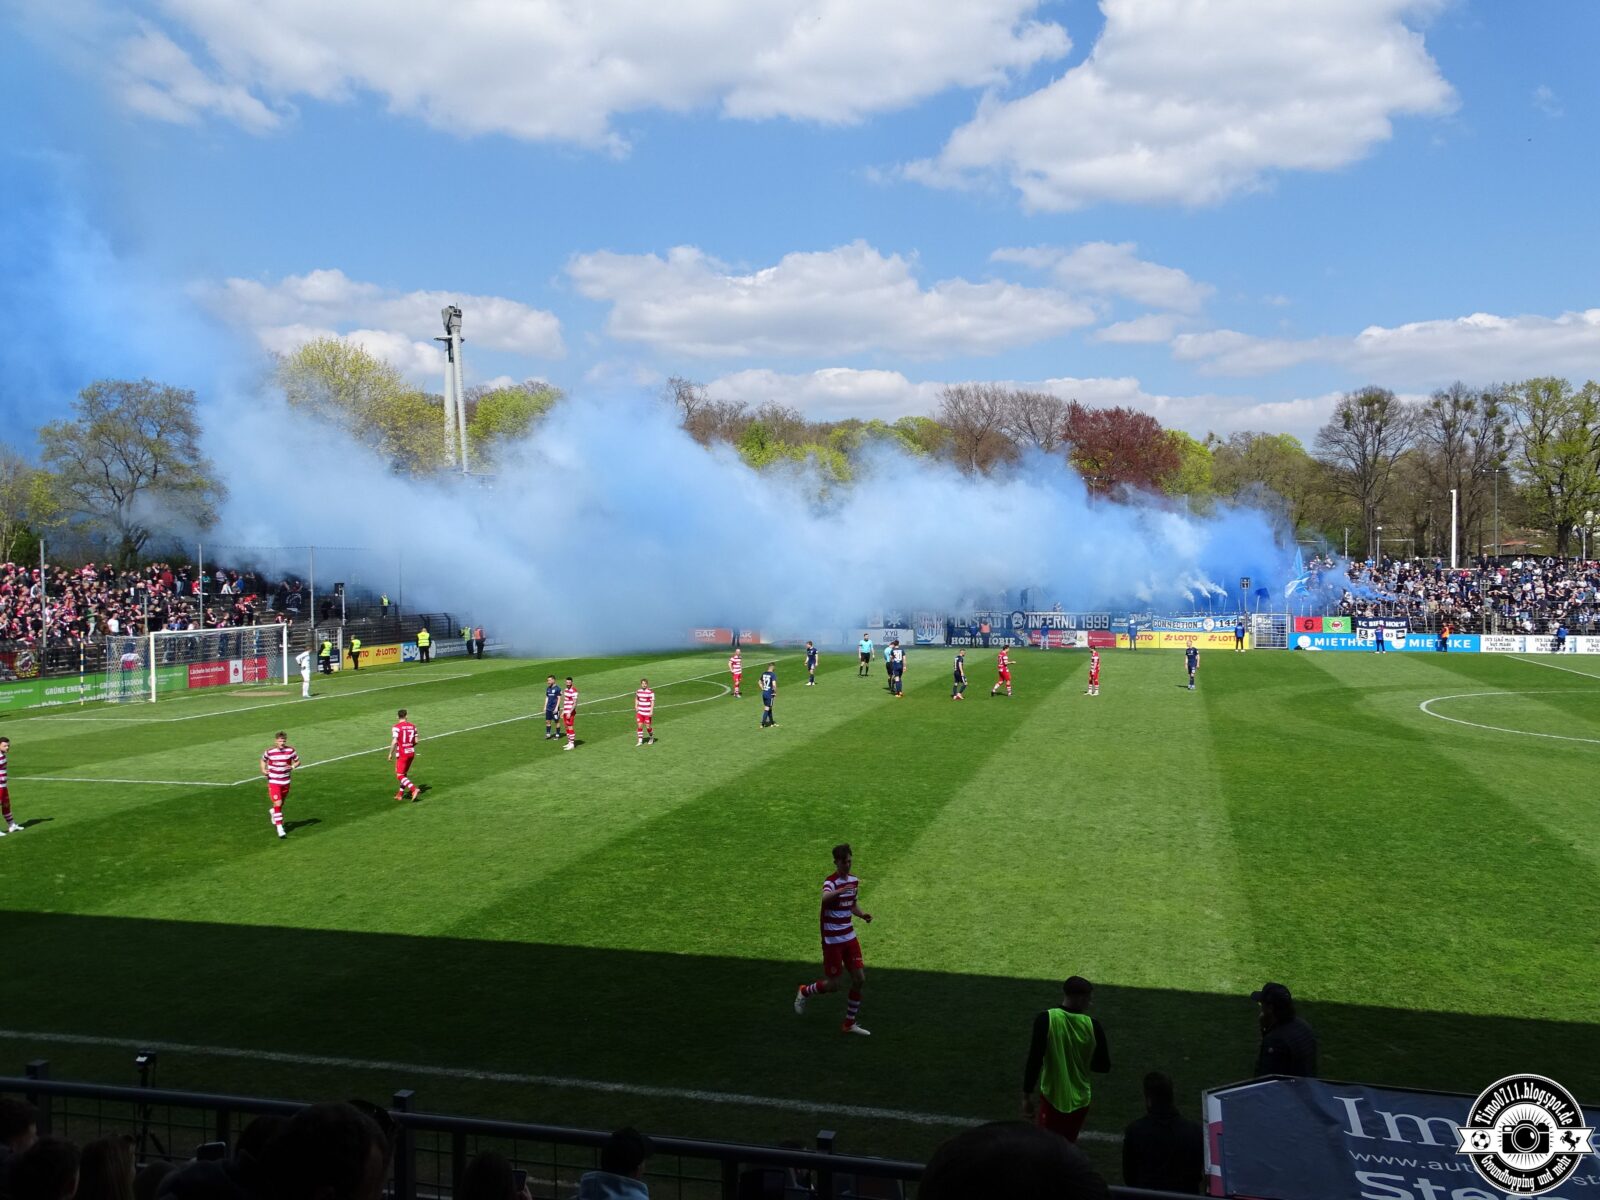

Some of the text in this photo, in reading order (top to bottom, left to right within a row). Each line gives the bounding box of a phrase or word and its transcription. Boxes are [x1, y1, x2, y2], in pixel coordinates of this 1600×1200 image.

[1081, 615, 1109, 629] 1999
[695, 629, 716, 638] DAK
[1315, 637, 1374, 647] MIETHKE
[381, 647, 398, 656] LOTTO
[402, 729, 415, 743] 17
